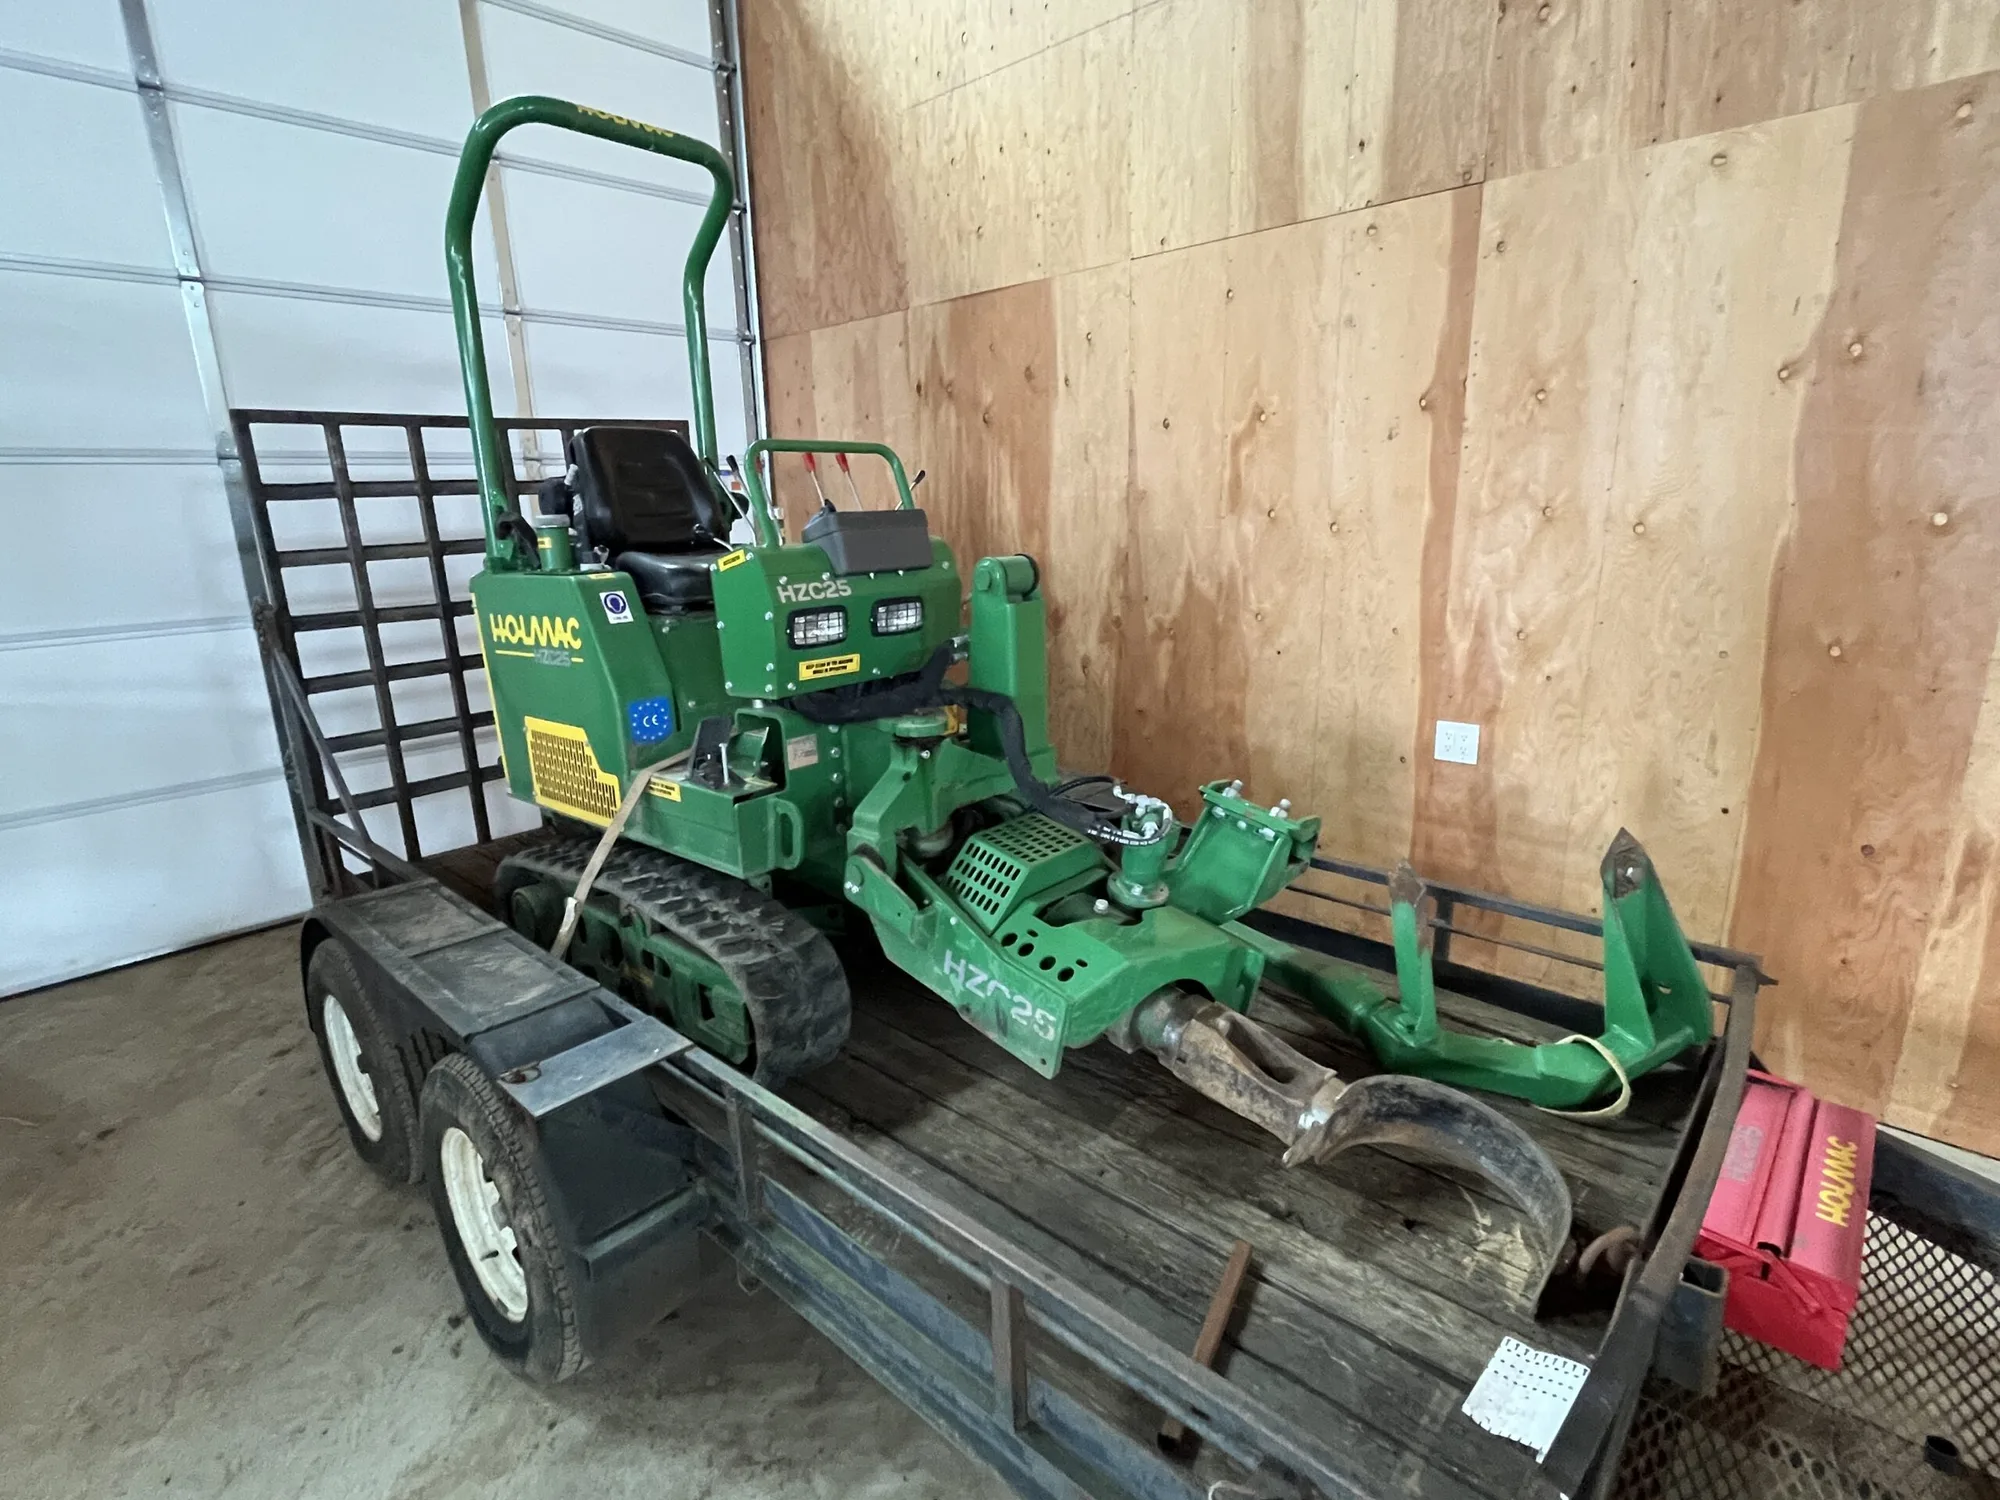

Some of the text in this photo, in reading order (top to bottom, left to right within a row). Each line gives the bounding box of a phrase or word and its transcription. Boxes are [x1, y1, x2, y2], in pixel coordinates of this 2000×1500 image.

[777, 579, 852, 604] HZC25
[489, 612, 582, 650] HOLMAC
[643, 714, 659, 728] CE
[1815, 1135, 1858, 1228] HOLMAC
